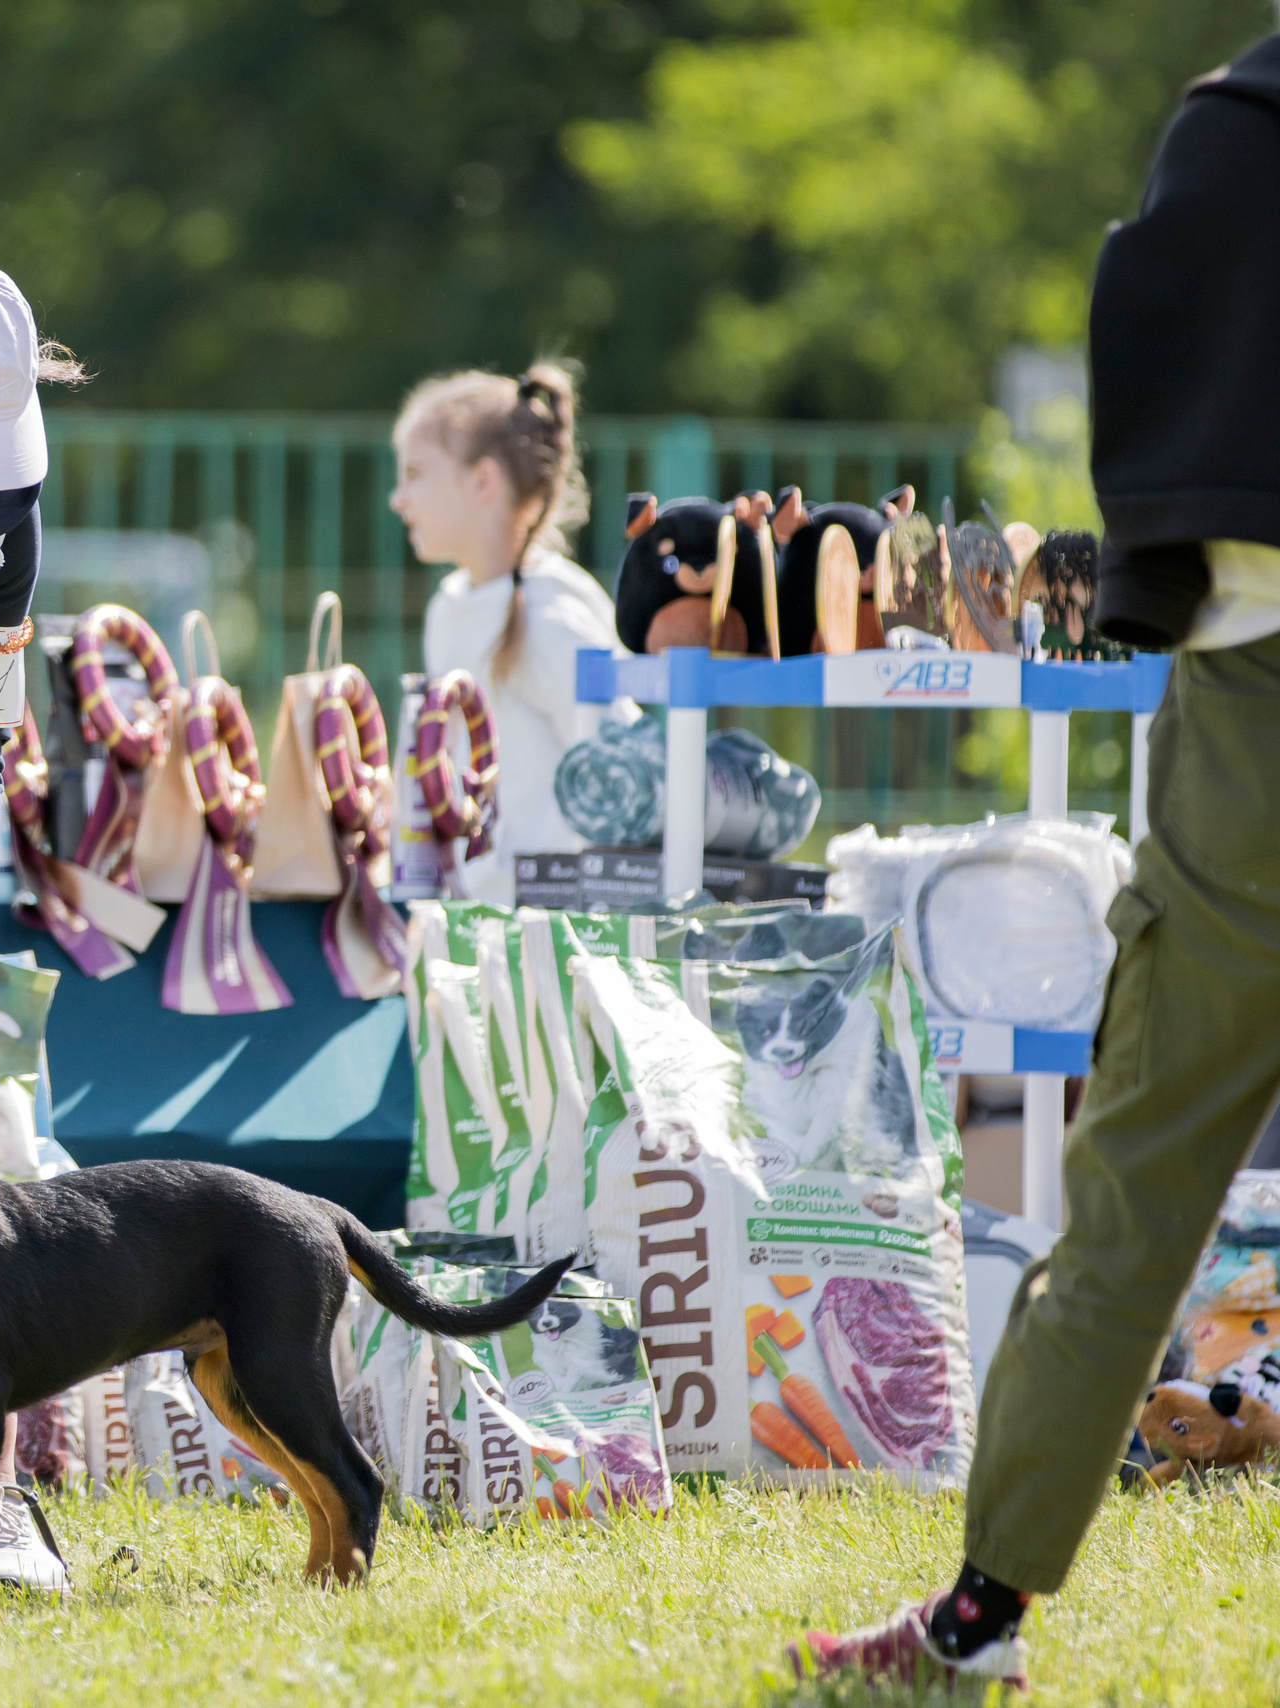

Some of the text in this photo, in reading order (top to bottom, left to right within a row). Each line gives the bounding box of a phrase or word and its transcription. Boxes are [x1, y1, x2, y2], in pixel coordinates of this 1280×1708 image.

[771, 1198, 861, 1216] ОВОЩАМИ
[773, 1223, 819, 1236] Комплекс
[820, 1225, 876, 1239] пробиотиков
[518, 1380, 546, 1395] 40%
[665, 1442, 719, 1456] EMIUM
